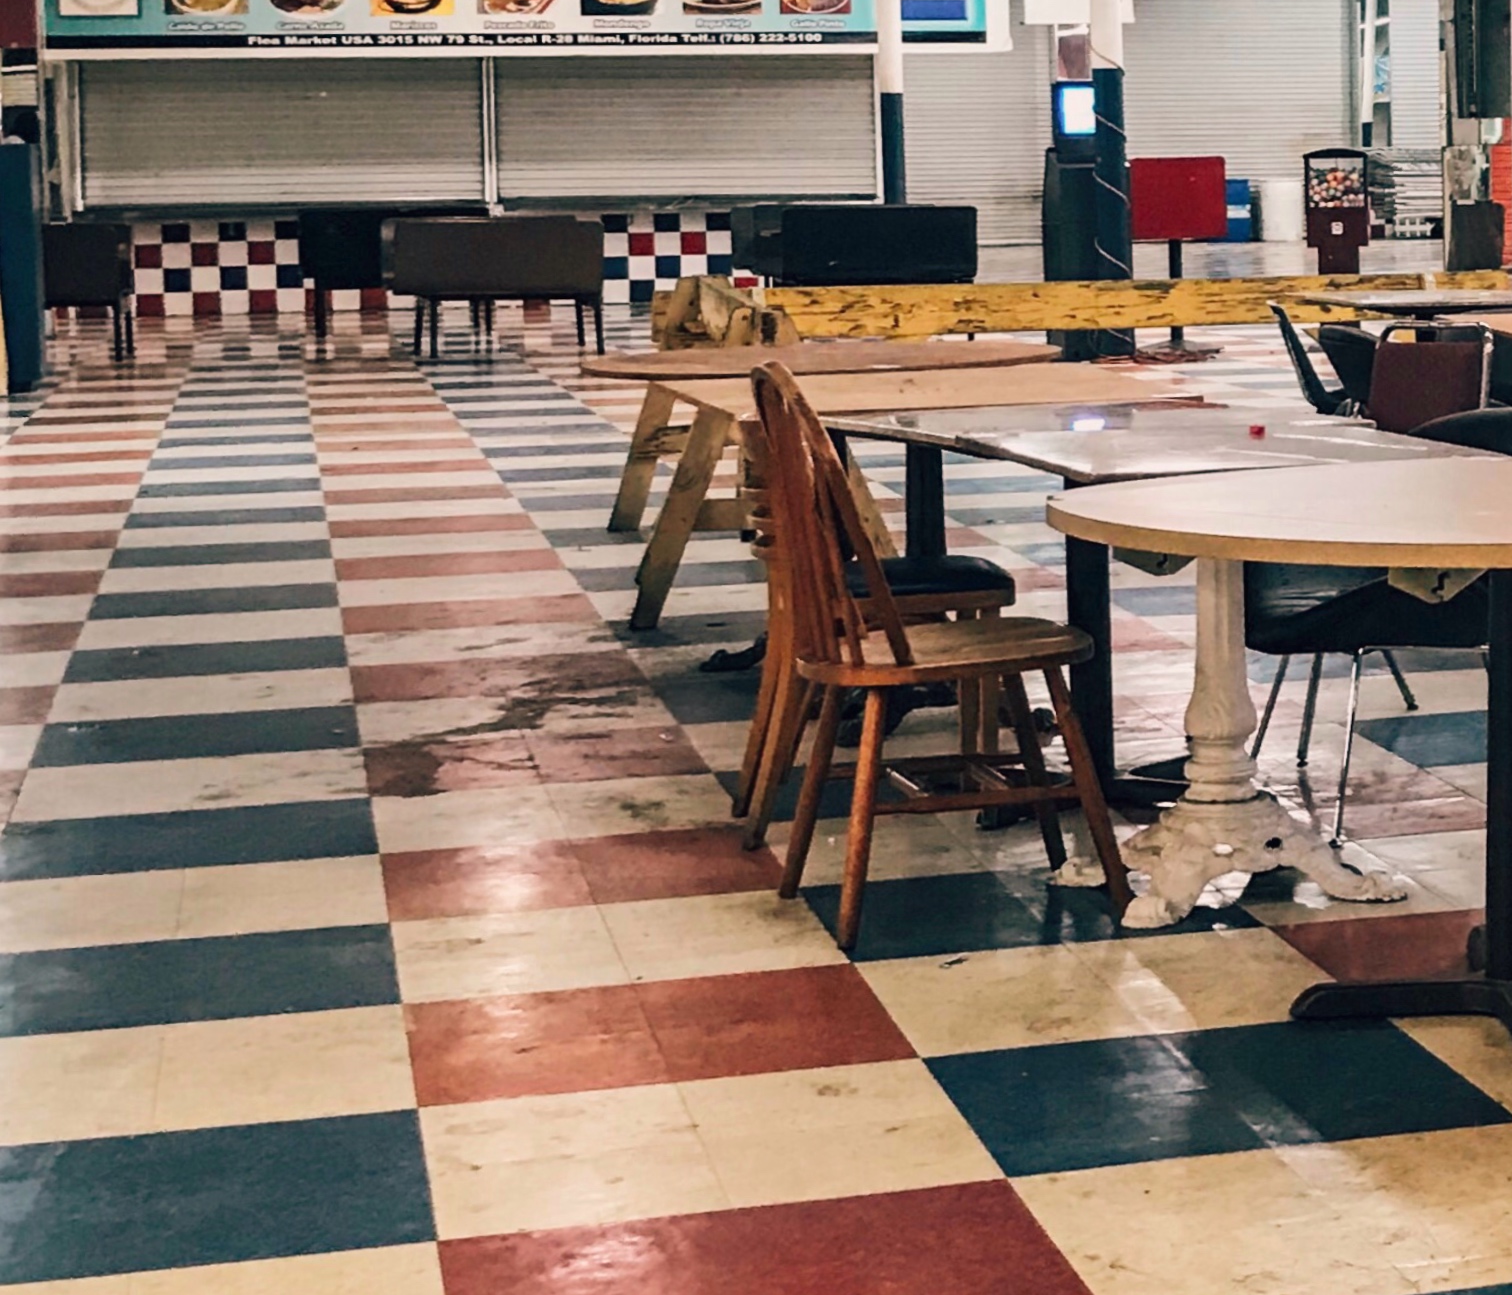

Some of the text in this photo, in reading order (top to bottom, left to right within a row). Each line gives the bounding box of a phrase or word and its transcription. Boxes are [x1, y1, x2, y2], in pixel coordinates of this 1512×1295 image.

[248, 36, 280, 46] Flea
[285, 35, 337, 45] Market
[341, 35, 374, 45] USA
[377, 35, 414, 45] 3015
[417, 35, 443, 45] NW
[497, 34, 537, 44] Local
[577, 33, 624, 45] Miami,
[628, 33, 678, 43] Florida
[759, 32, 823, 43] 222-5100
